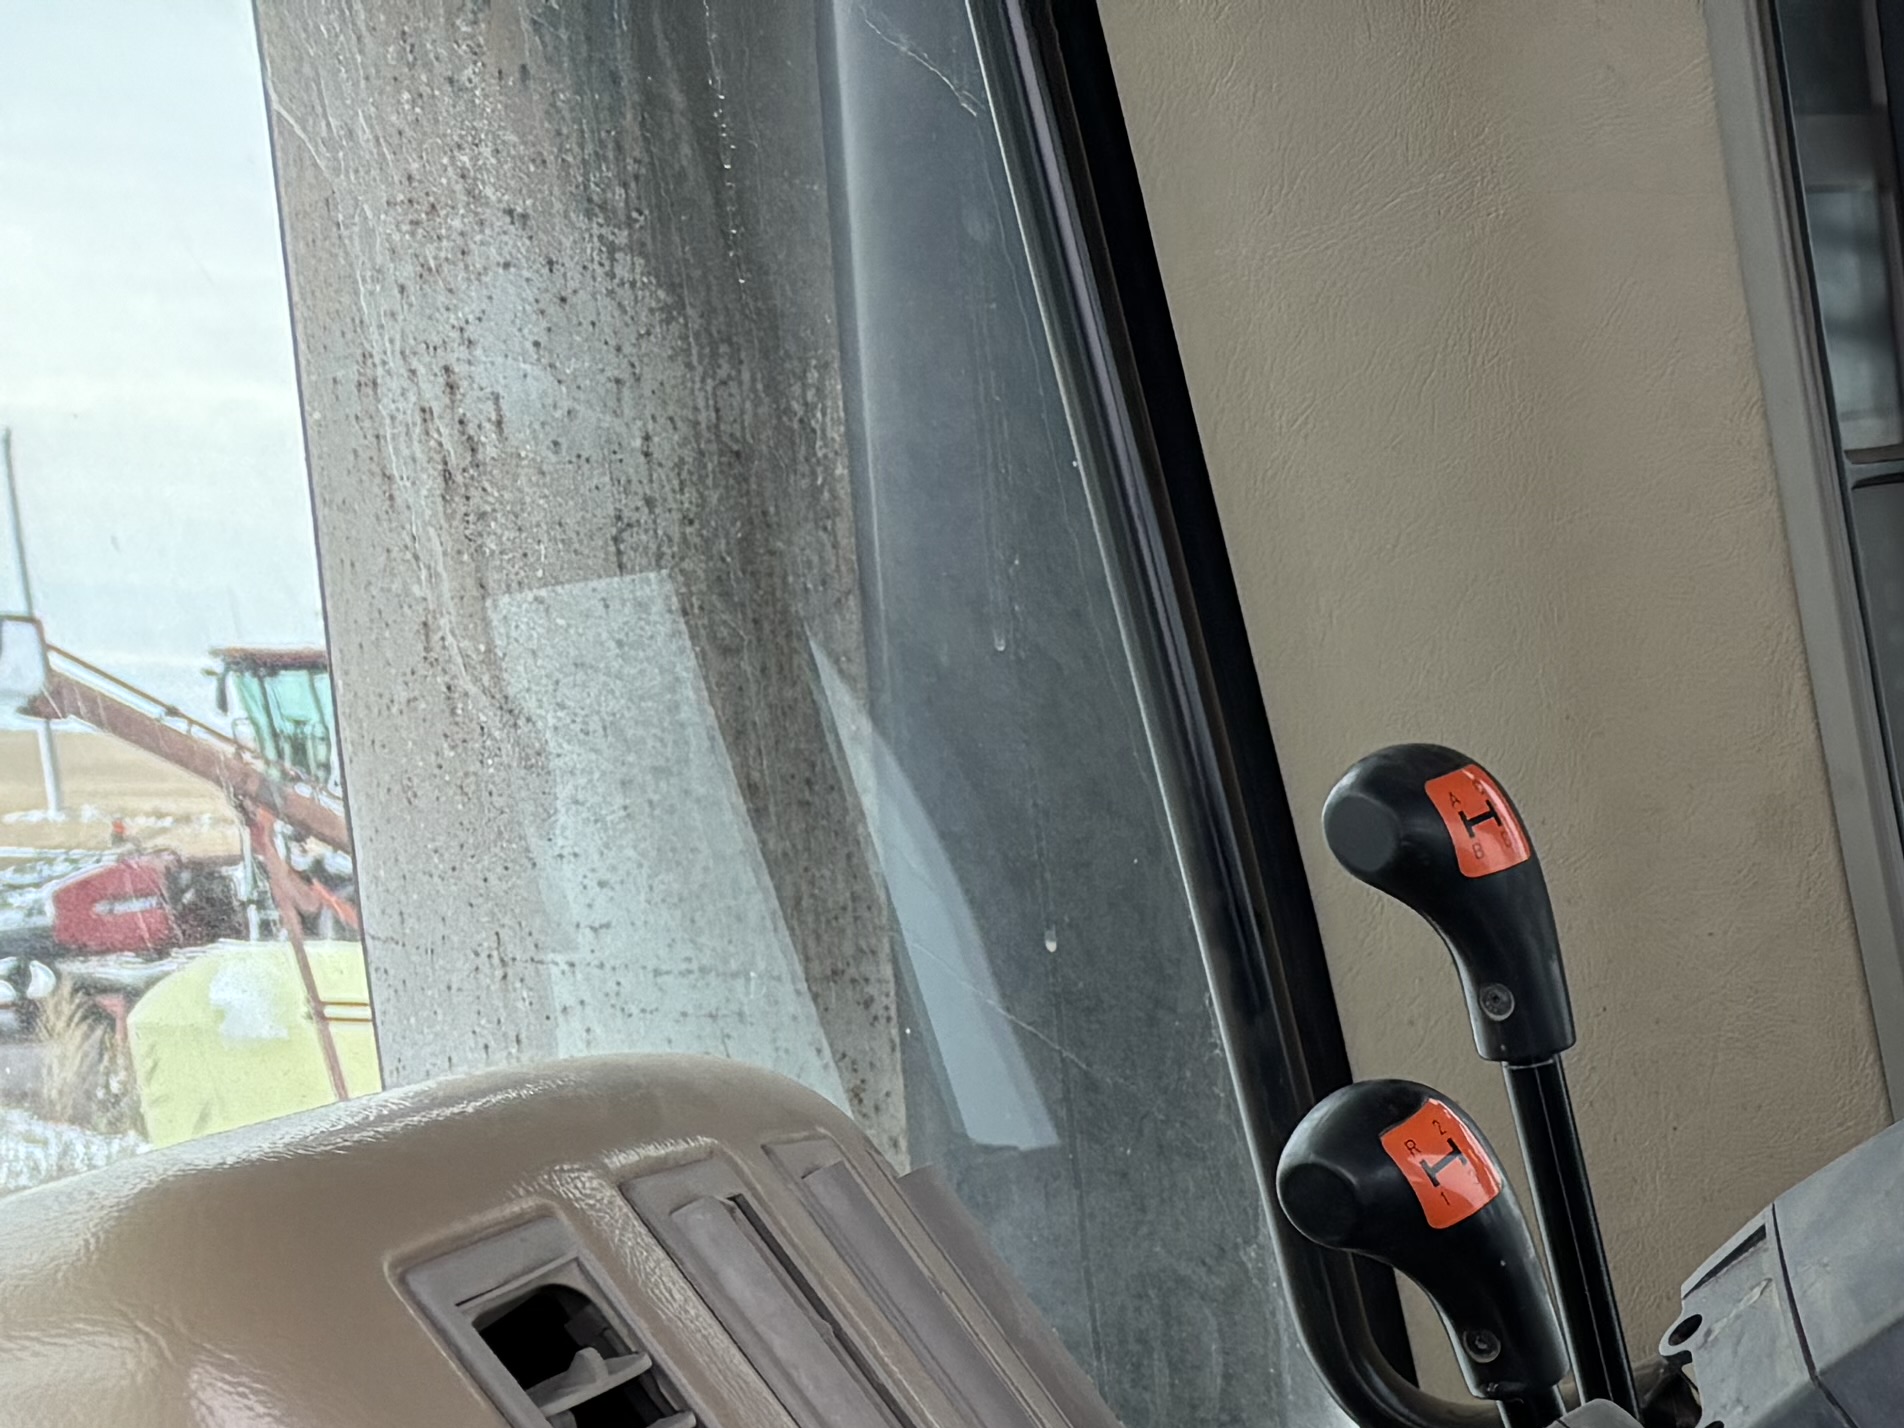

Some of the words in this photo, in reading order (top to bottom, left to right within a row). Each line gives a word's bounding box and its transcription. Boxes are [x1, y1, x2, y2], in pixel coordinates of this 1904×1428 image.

[1449, 792, 1461, 808] A
[1432, 1120, 1446, 1135] 2
[1404, 1139, 1422, 1157] R
[1440, 1192, 1450, 1205] 1
